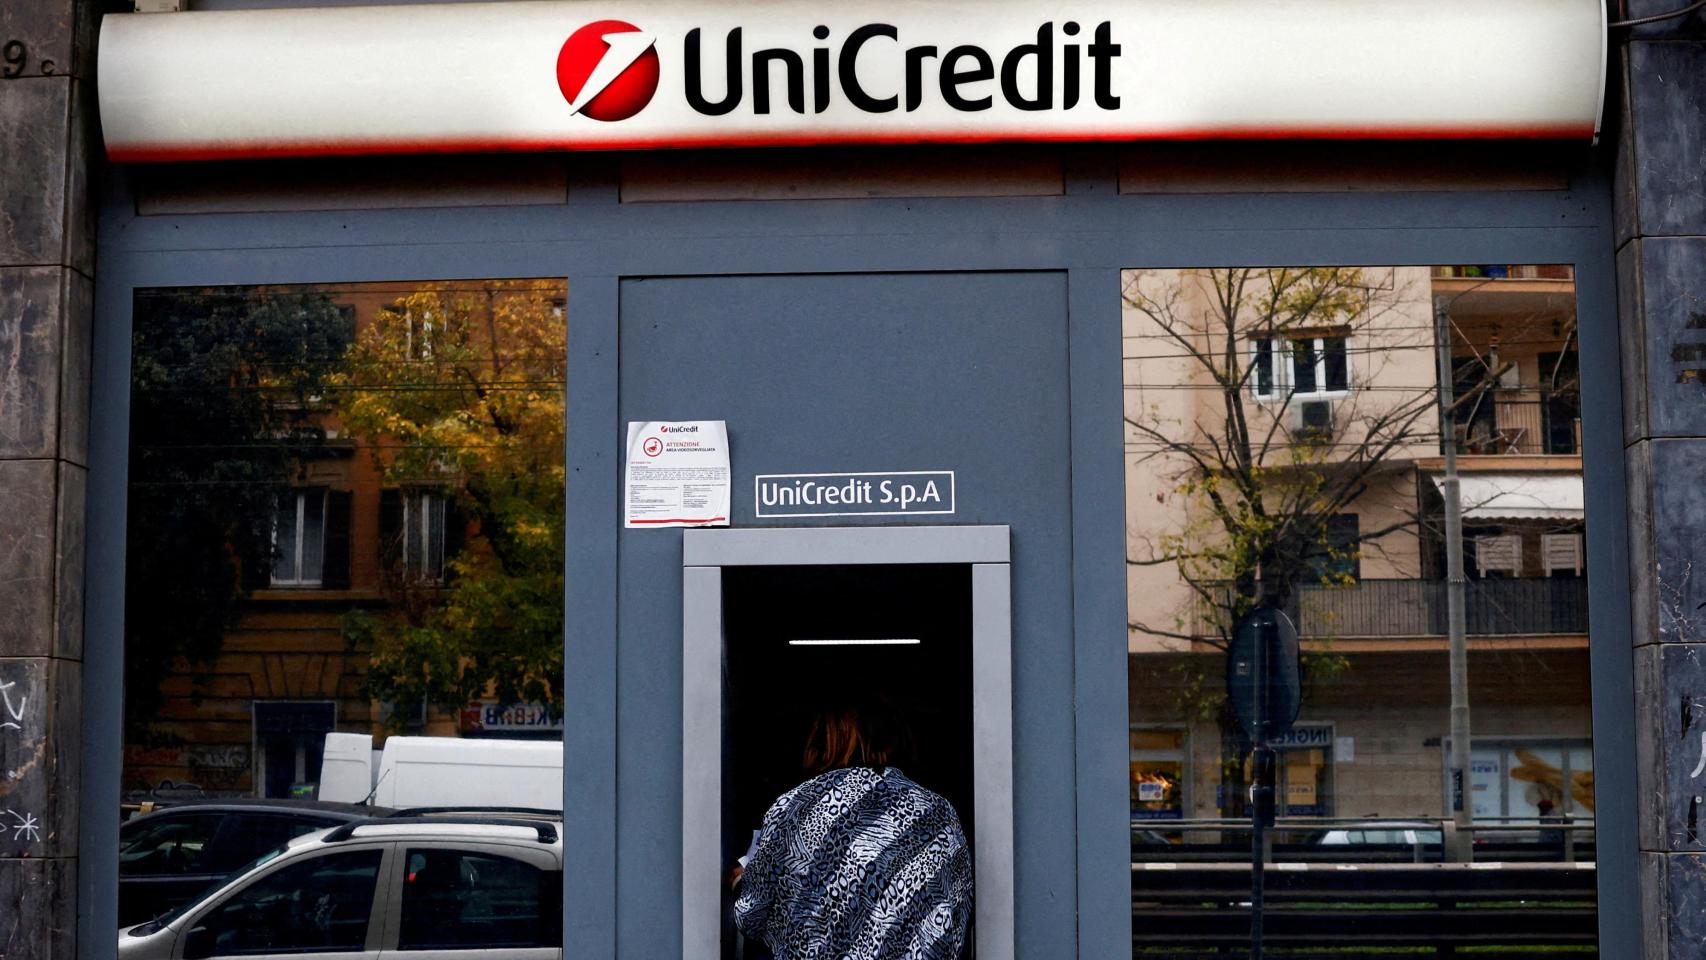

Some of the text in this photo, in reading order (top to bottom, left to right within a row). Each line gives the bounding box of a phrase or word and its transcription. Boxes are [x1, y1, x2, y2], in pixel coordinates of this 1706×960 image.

[3, 40, 27, 79] 9
[683, 21, 1122, 116] UniCredit
[762, 478, 873, 506] UniCredit
[879, 480, 941, 510] S.p.A
